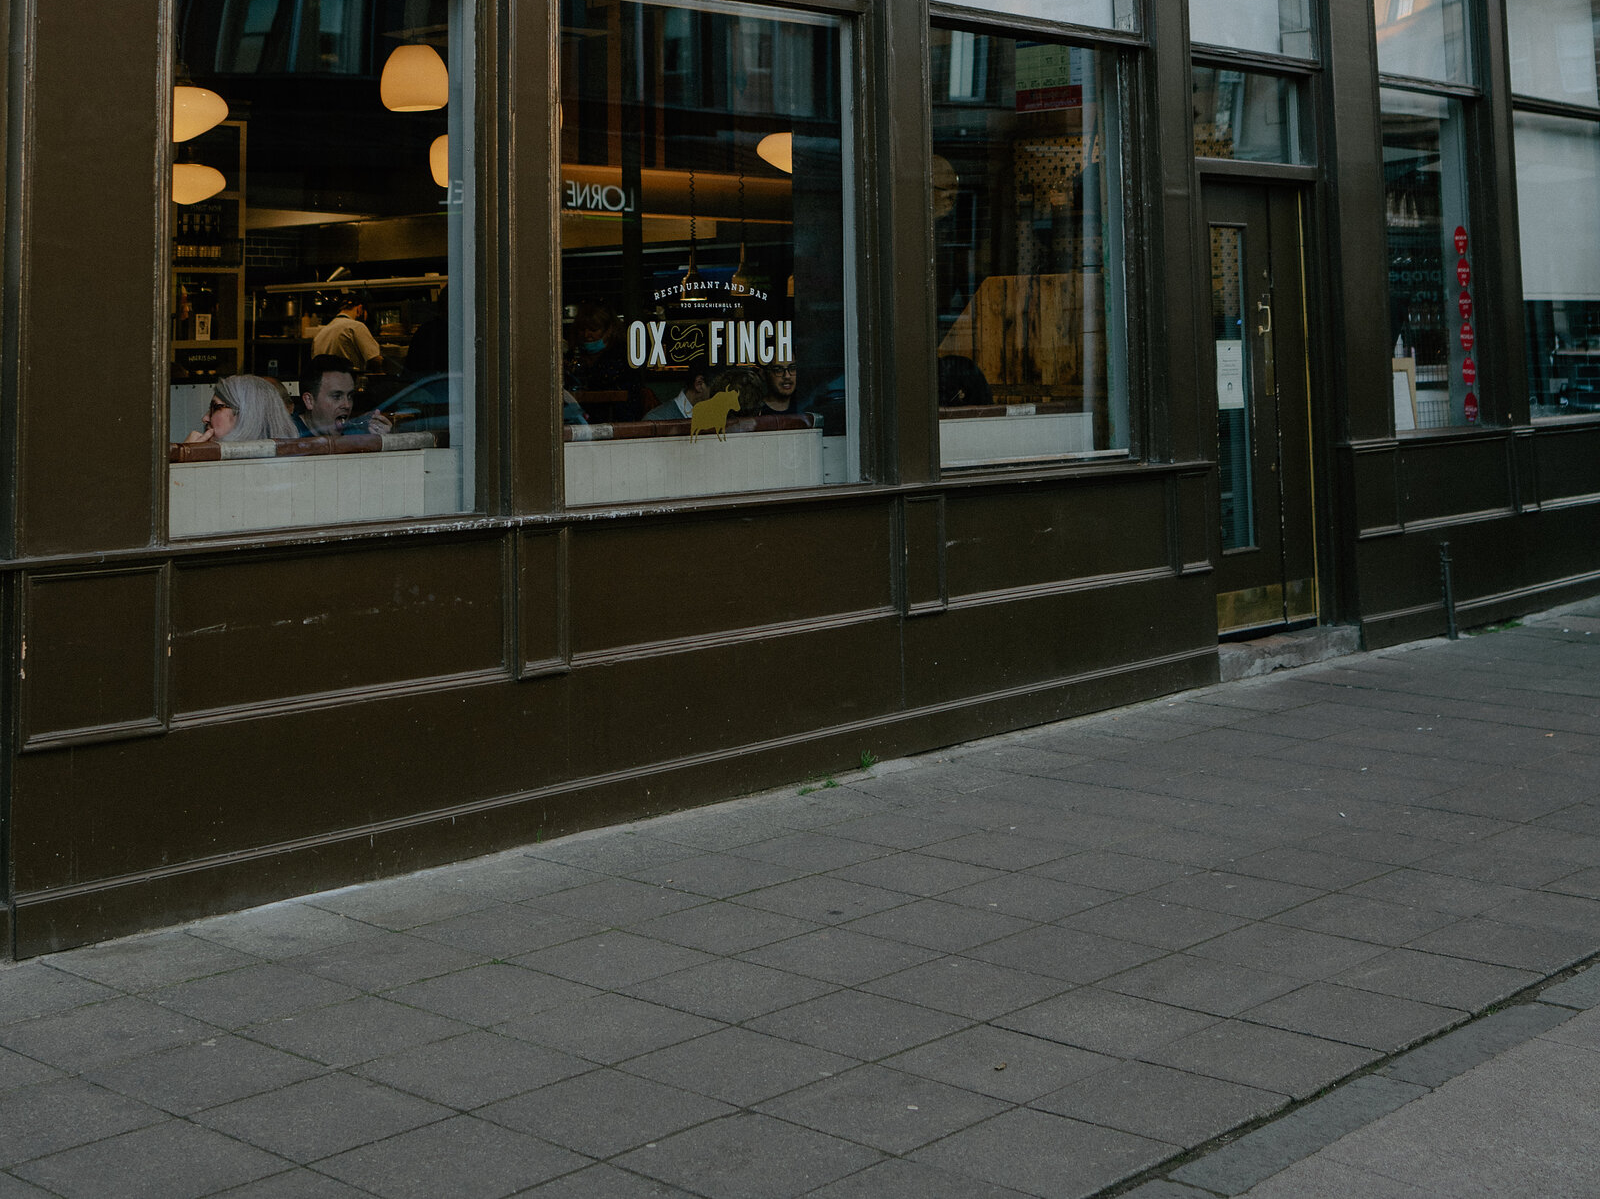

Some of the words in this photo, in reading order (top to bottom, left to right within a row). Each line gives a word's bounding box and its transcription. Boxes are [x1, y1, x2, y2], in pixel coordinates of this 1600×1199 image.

[653, 281, 720, 301] RESTAURANT
[724, 282, 745, 293] AND
[749, 287, 768, 301] BAR
[627, 320, 667, 369] OX
[669, 333, 706, 353] and
[708, 320, 793, 367] FINCH
